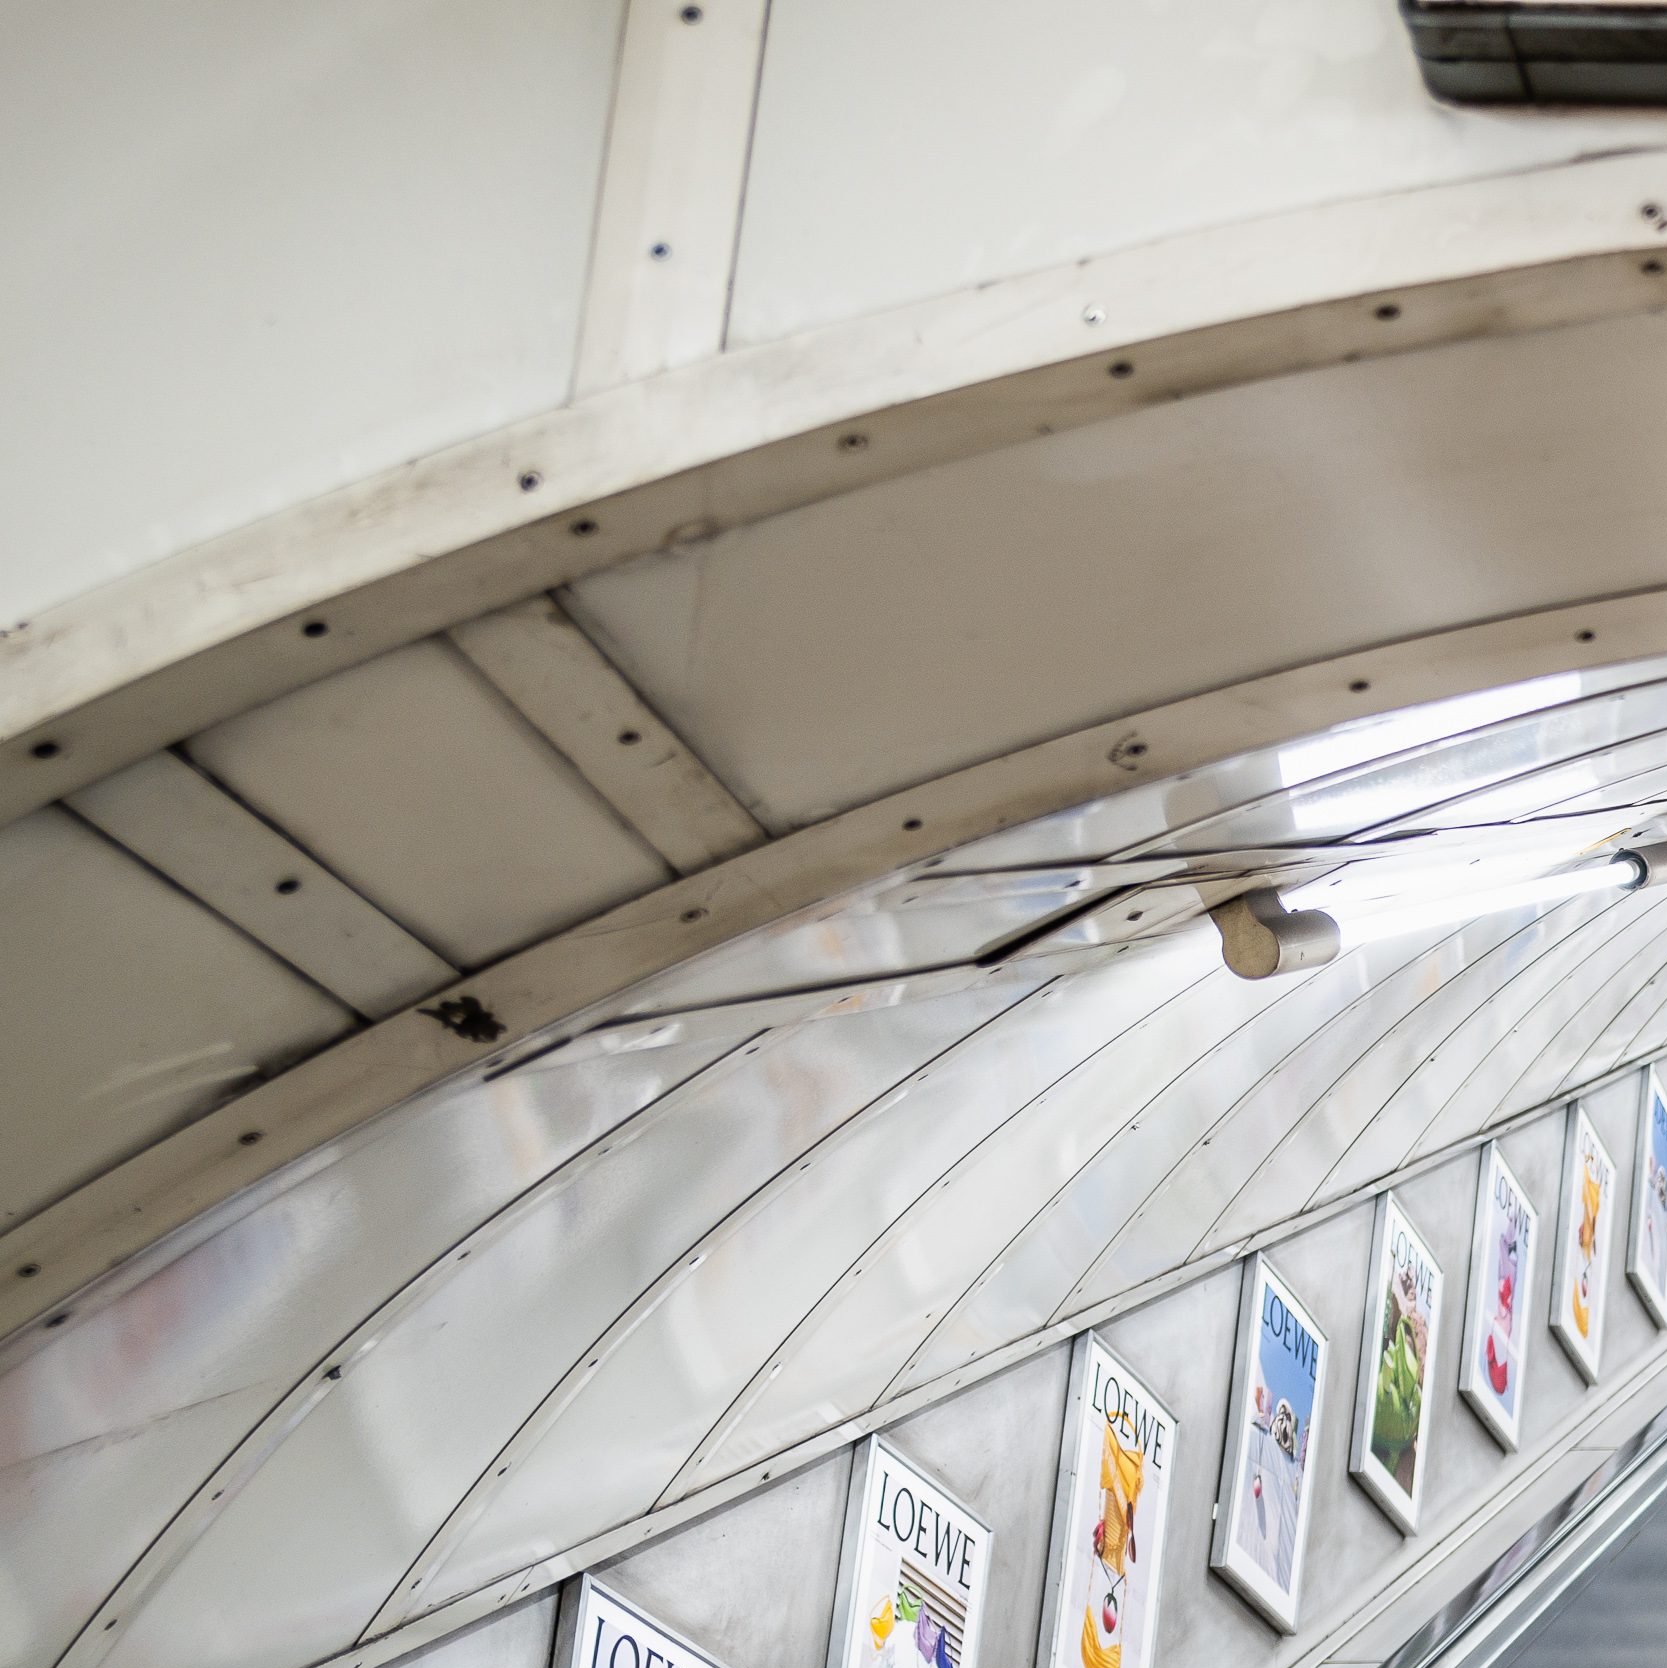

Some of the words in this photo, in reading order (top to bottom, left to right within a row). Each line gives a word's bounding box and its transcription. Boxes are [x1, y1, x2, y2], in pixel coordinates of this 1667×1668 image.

[1390, 1218, 1435, 1309] LOEWE
[1261, 1281, 1319, 1381] LOEWE
[1091, 1360, 1166, 1470] LOEWE
[876, 1470, 976, 1591] LOEWE
